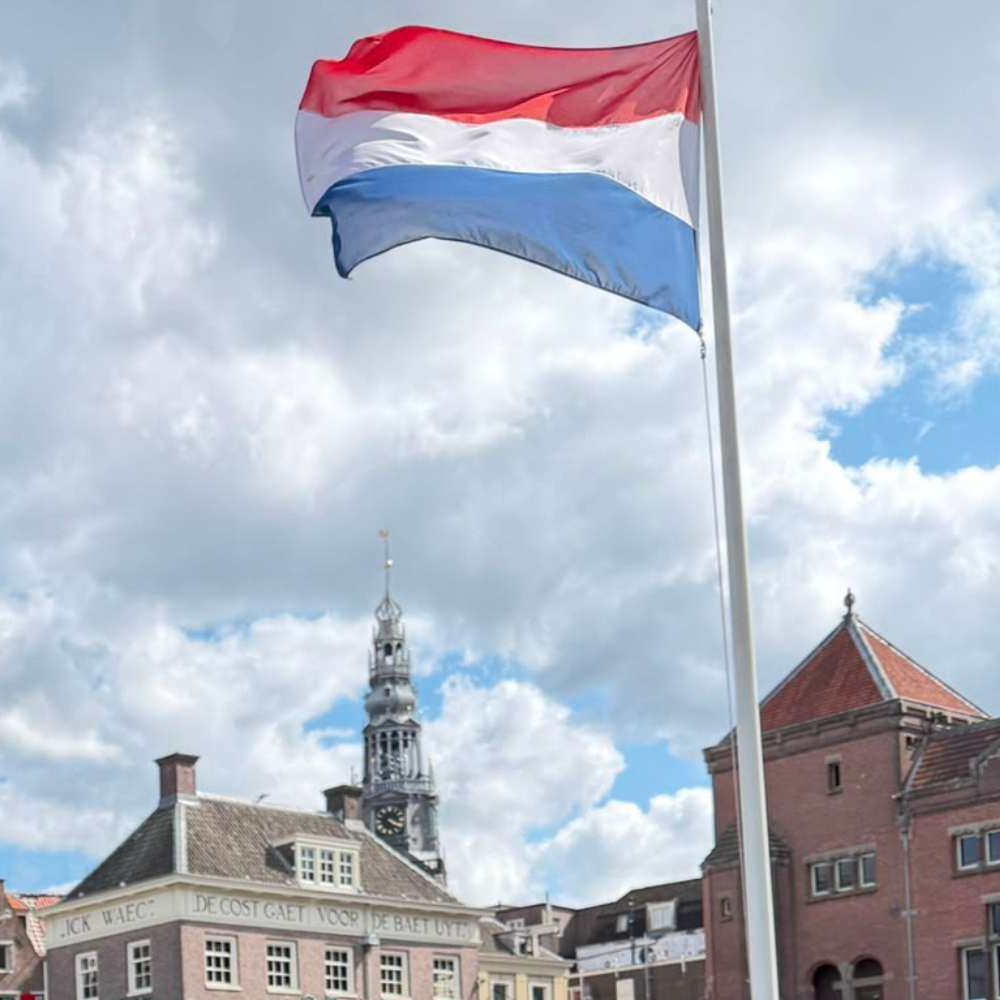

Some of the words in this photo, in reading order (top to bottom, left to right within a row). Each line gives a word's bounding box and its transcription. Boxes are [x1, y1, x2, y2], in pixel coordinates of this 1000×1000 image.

[193, 894, 217, 914] DE
[219, 897, 259, 918] COST
[263, 901, 305, 922] GAET
[316, 906, 359, 928] VOOR
[371, 911, 390, 931] DE
[393, 914, 430, 936] BAET
